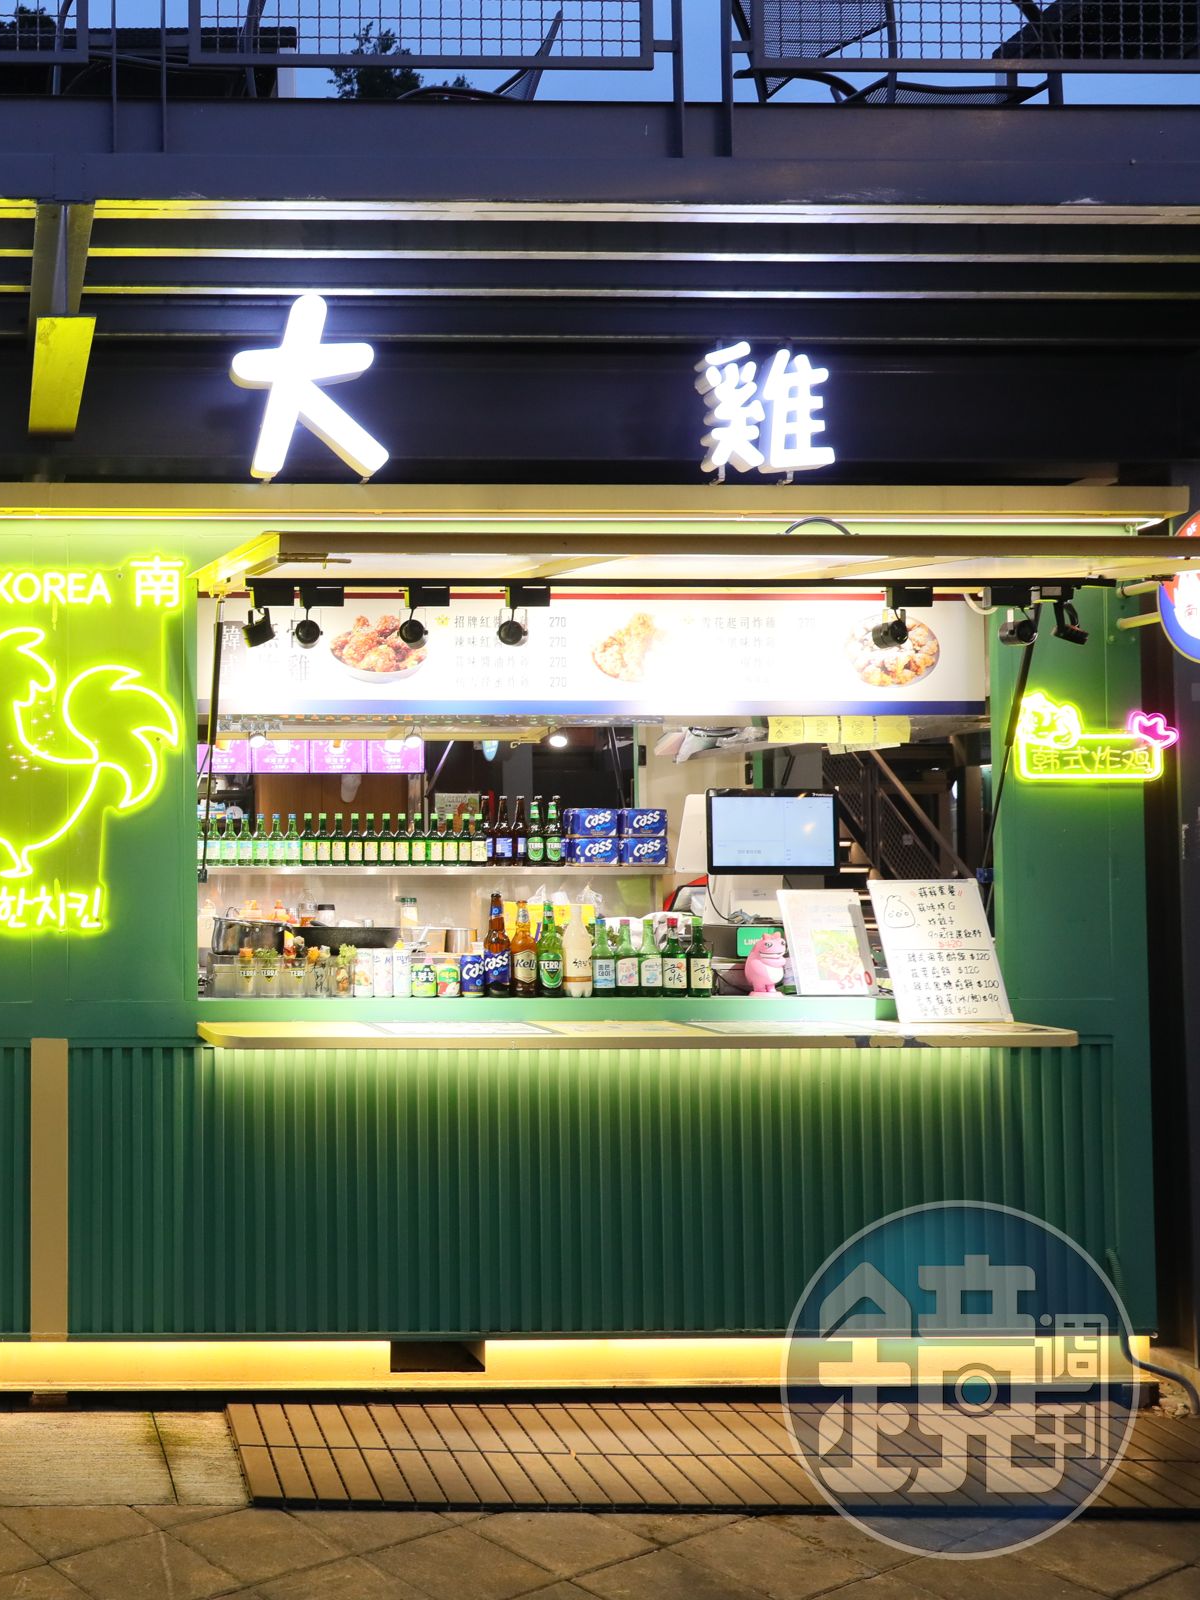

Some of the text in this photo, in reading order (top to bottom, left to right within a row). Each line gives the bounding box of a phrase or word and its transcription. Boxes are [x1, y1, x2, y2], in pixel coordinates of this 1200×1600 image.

[129, 555, 184, 608] 南
[548, 616, 567, 628] 270
[548, 636, 567, 648] 270
[549, 656, 567, 668] 270
[549, 676, 567, 688] 270
[1031, 745, 1152, 773] 韩式炸鸡
[584, 810, 612, 829] Cass
[632, 810, 660, 829] Cass
[584, 839, 613, 857] Cass
[633, 839, 661, 857] Cass
[484, 953, 509, 972] Cass
[969, 952, 990, 961] $120
[976, 980, 1000, 989] $100
[982, 992, 999, 1003] $90
